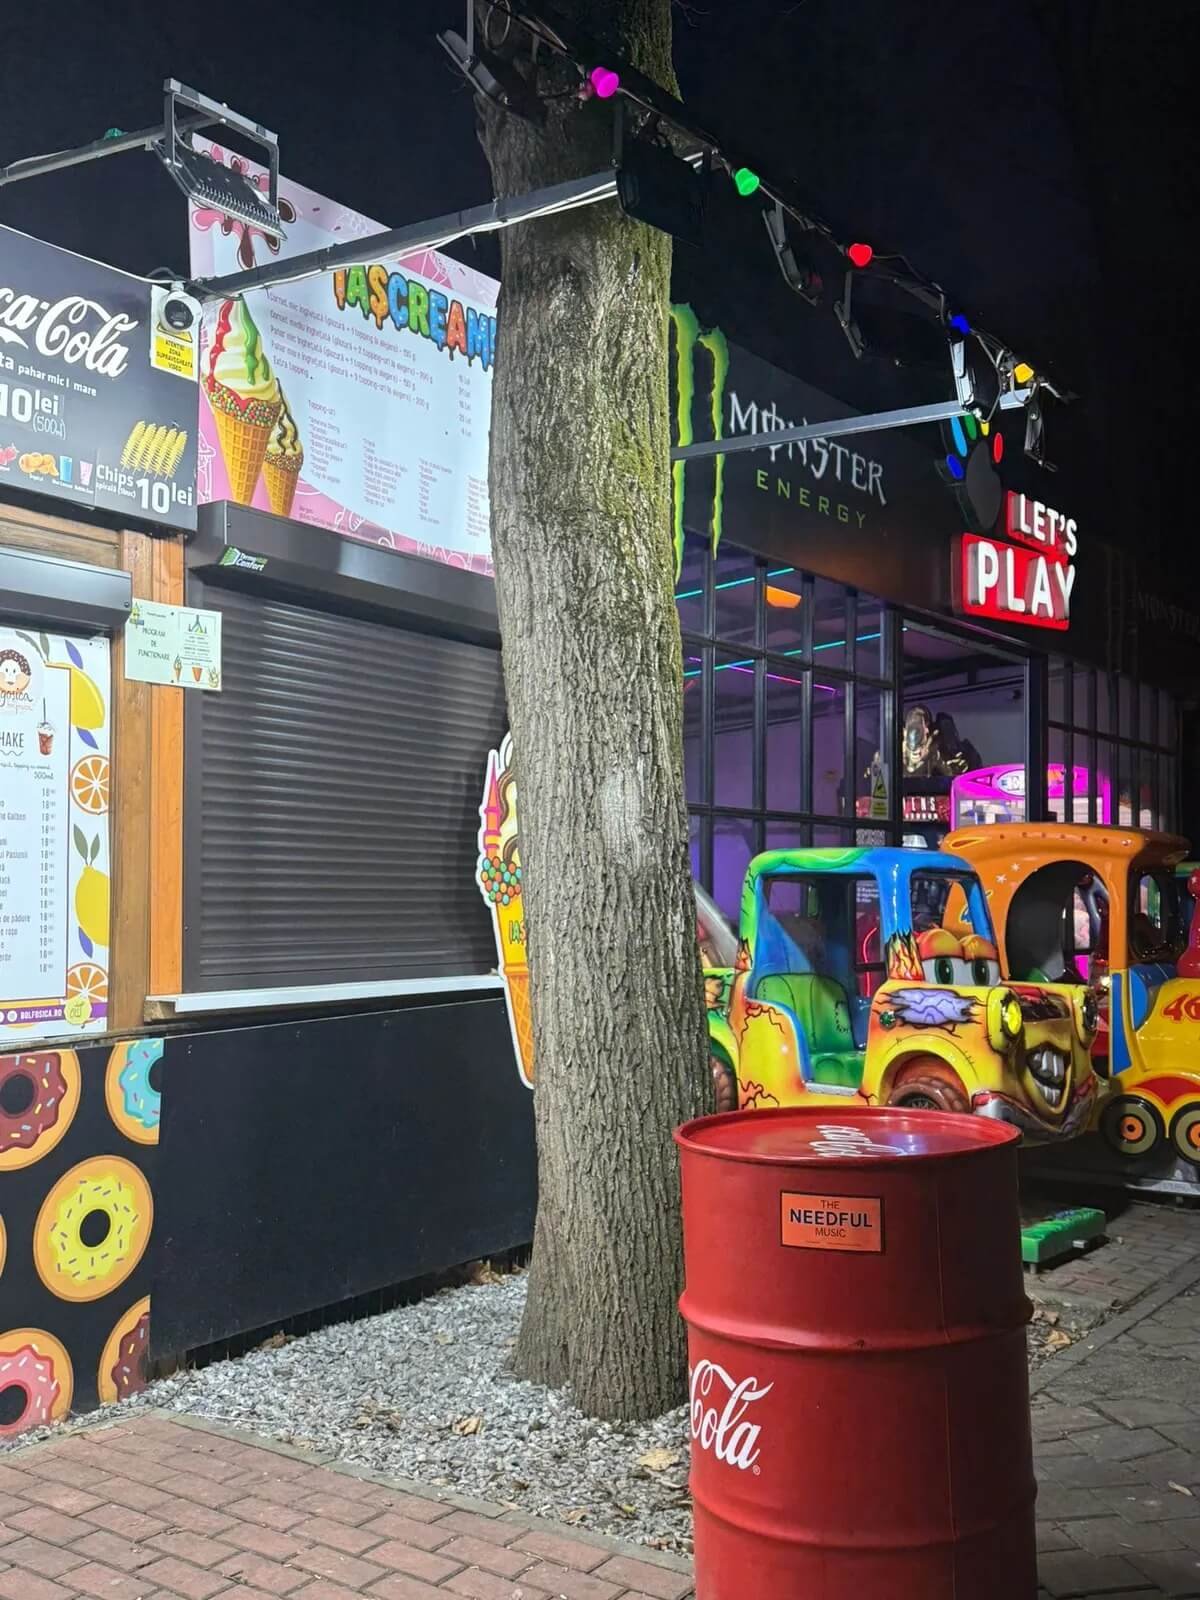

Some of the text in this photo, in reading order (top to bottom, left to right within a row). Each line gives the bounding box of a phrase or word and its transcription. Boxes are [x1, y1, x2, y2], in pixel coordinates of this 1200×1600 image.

[18, 365, 47, 380] pahar
[47, 374, 65, 386] mic
[73, 382, 97, 397] mare
[35, 389, 59, 417] lei
[96, 464, 134, 488] Chips
[136, 478, 192, 514] 10 lei
[756, 469, 866, 529] ENERGY
[977, 540, 1076, 618] PLAY
[790, 1208, 873, 1227] NEEDFUL
[820, 1199, 841, 1210] THE
[815, 1227, 847, 1238] MUSIC
